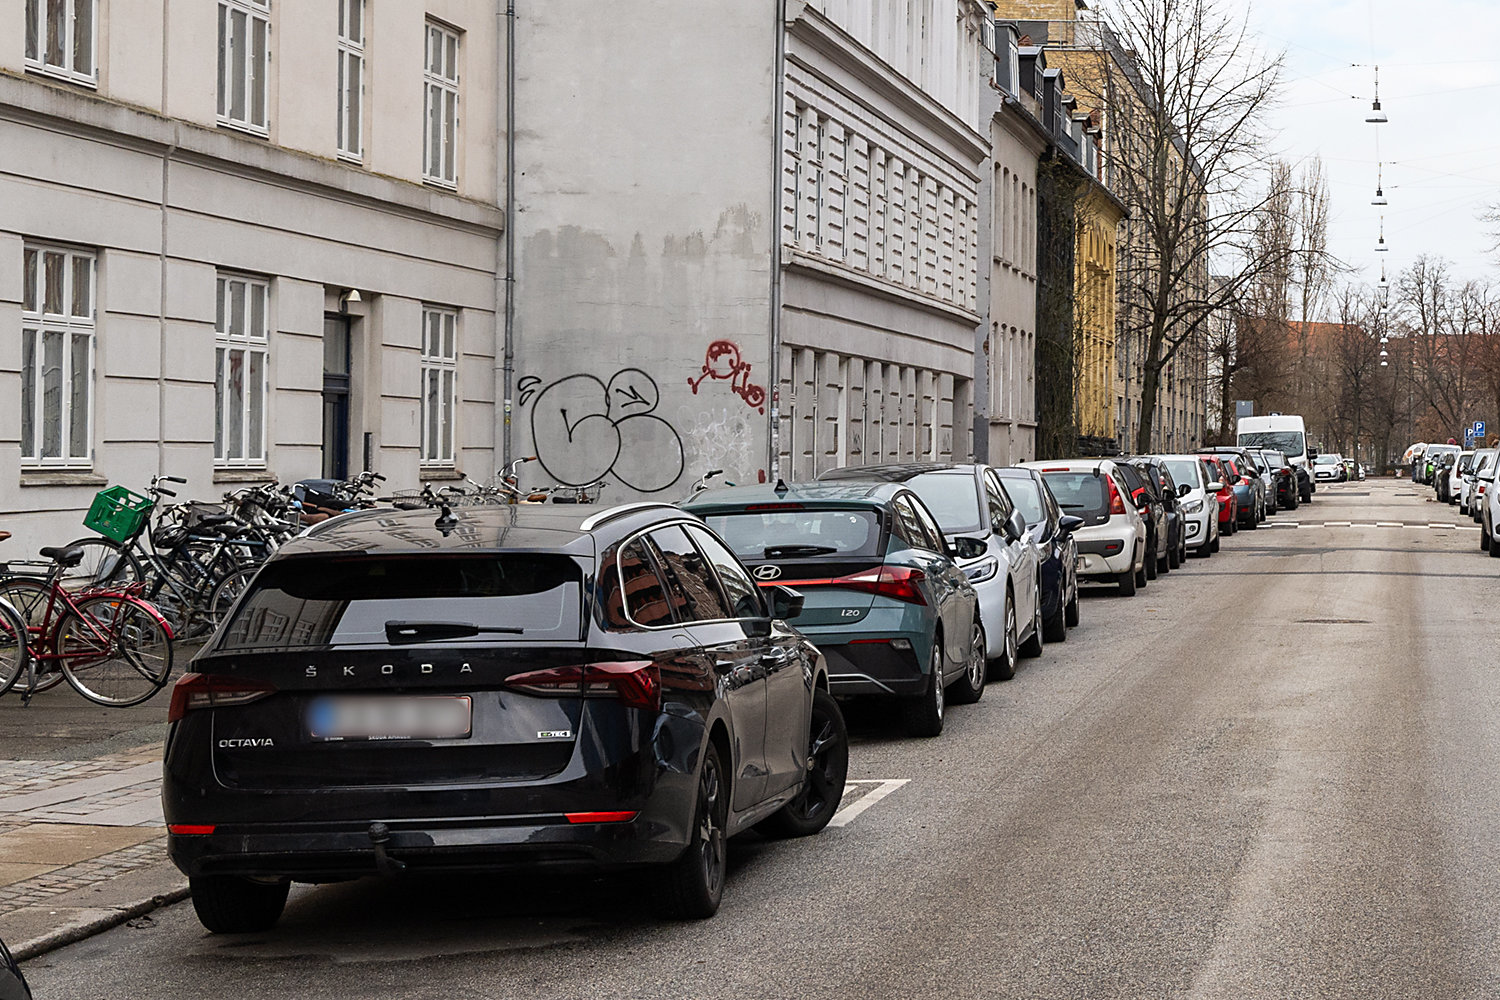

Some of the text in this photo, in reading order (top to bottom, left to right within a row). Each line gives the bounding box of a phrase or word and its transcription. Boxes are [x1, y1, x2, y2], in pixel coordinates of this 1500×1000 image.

[1476, 423, 1483, 432] P
[305, 663, 473, 678] ŠKODA
[218, 738, 274, 748] OCTAVIA
